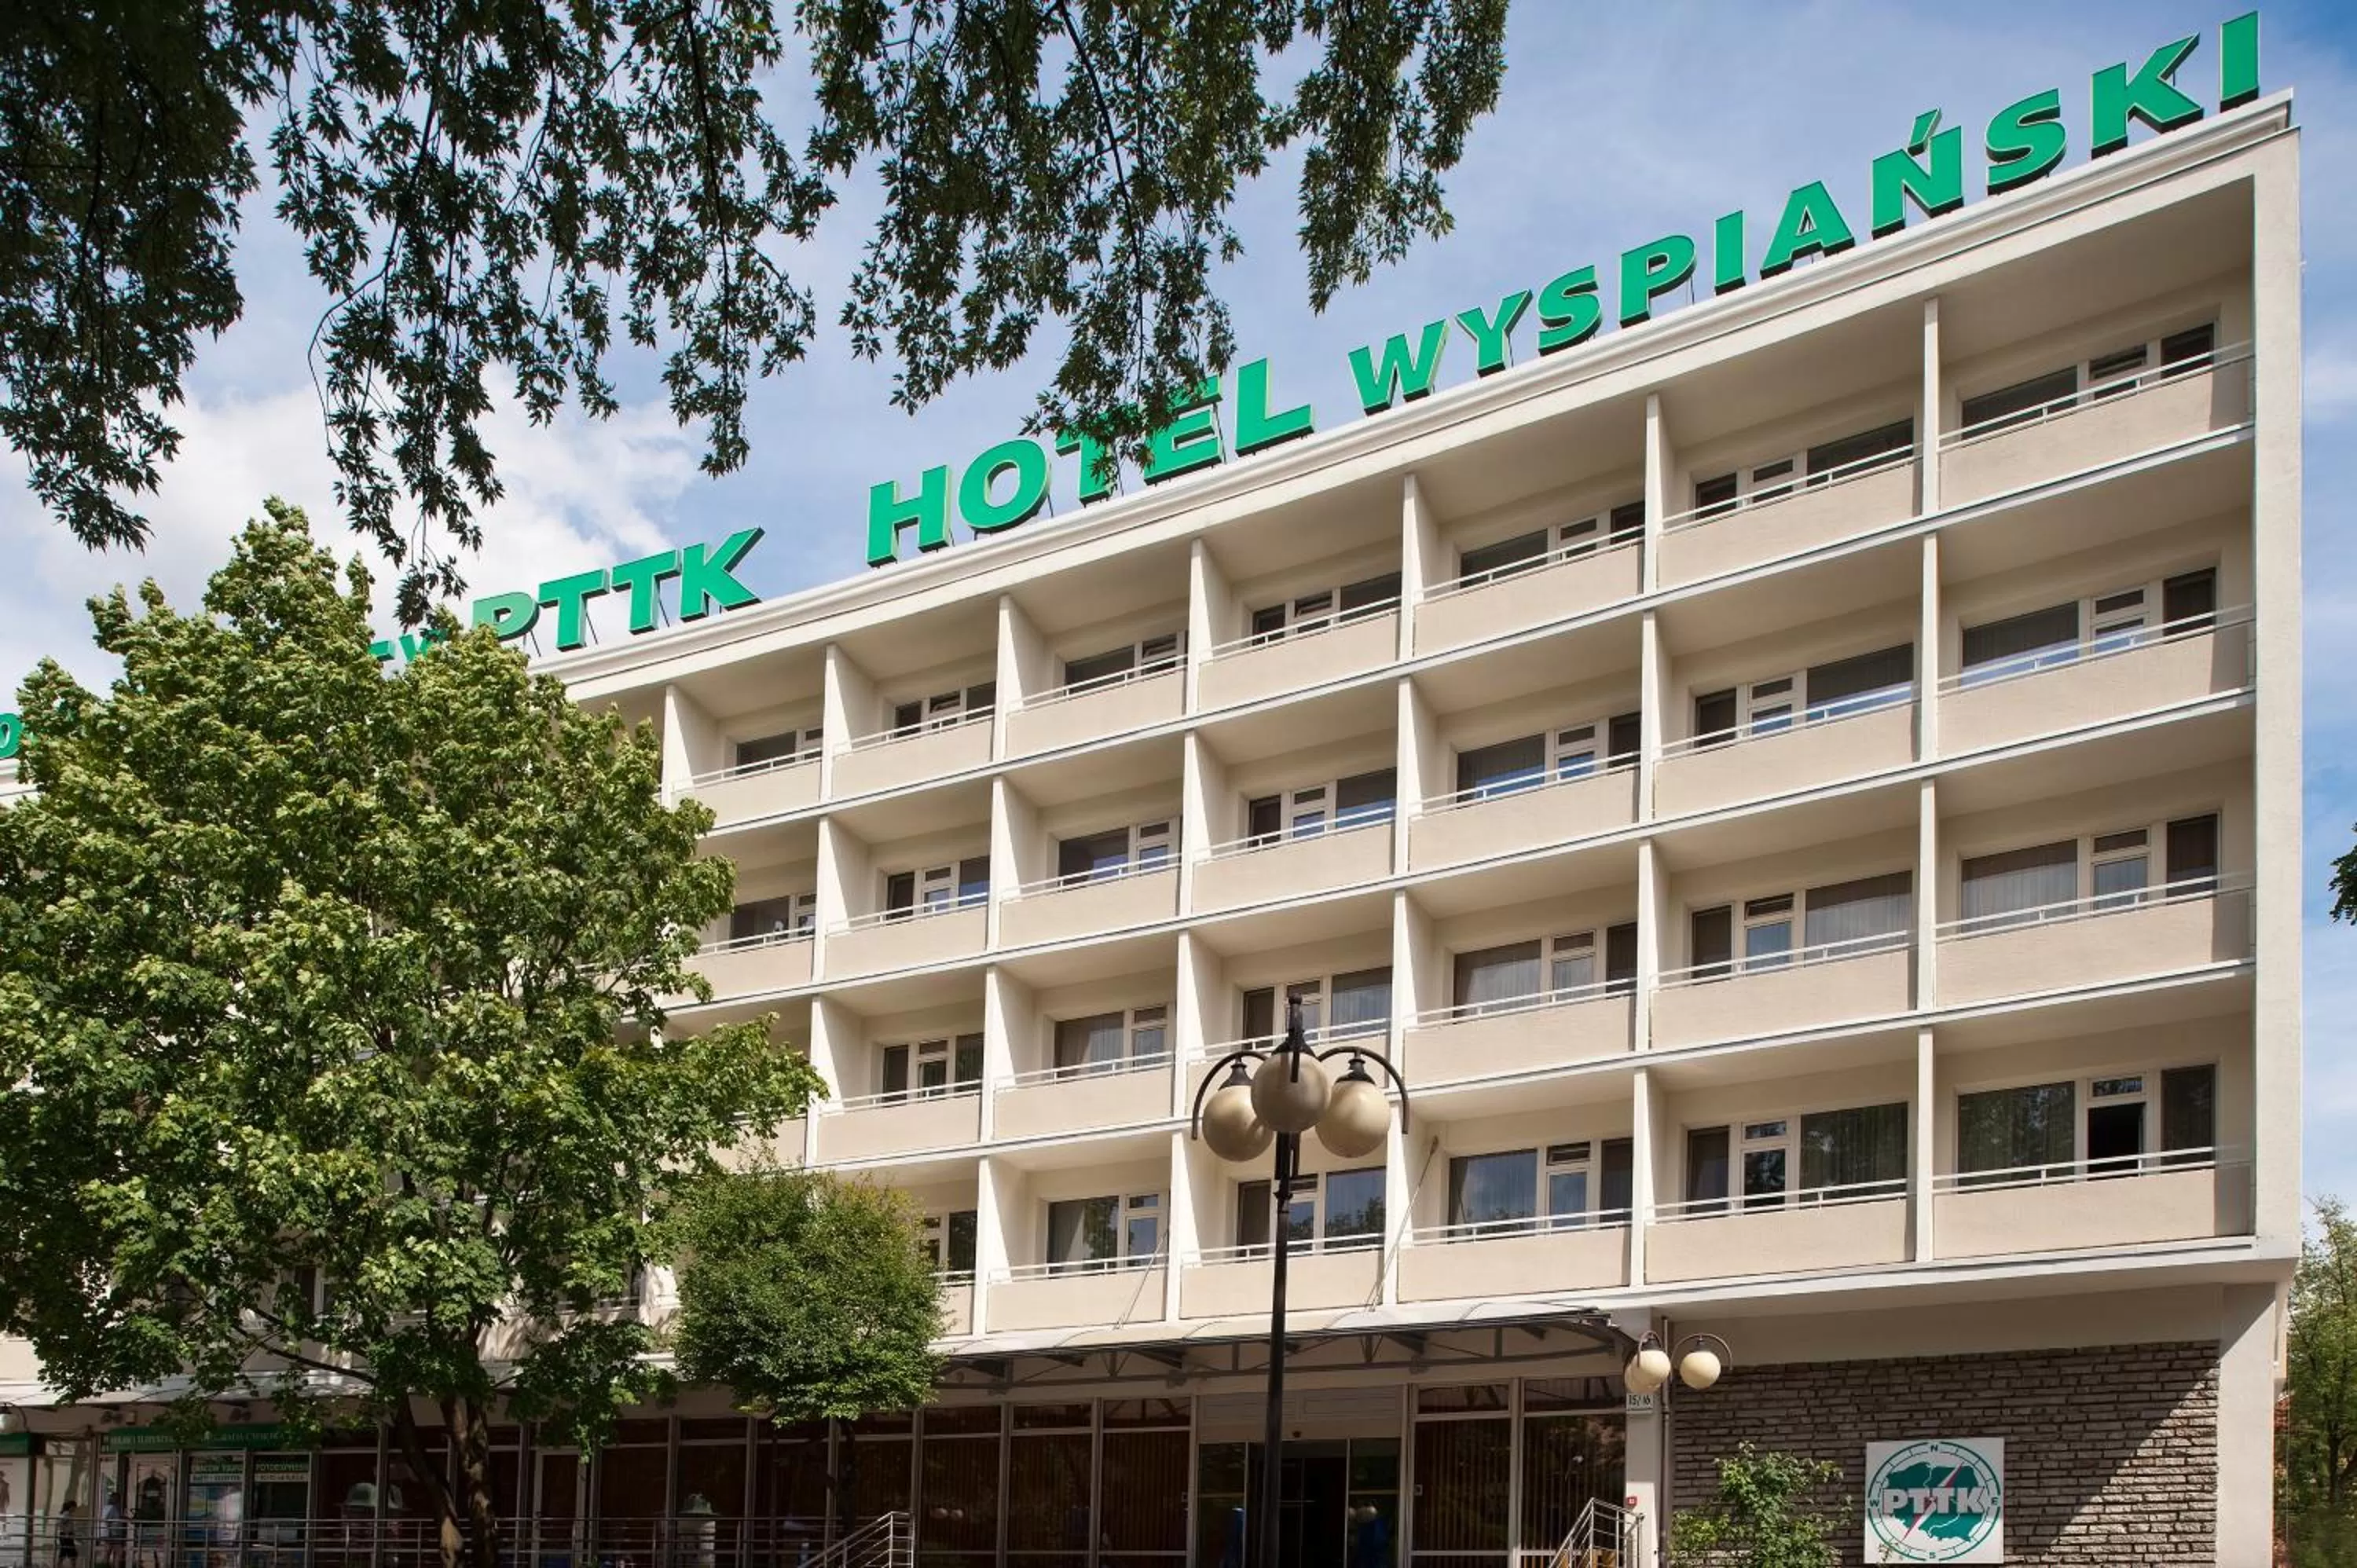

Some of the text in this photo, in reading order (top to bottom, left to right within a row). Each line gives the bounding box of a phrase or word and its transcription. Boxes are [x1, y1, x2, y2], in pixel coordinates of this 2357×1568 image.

[473, 11, 2260, 651] PTTK HOTEL WYSPIAŃSKI
[1882, 1486, 1985, 1514] PTTK
